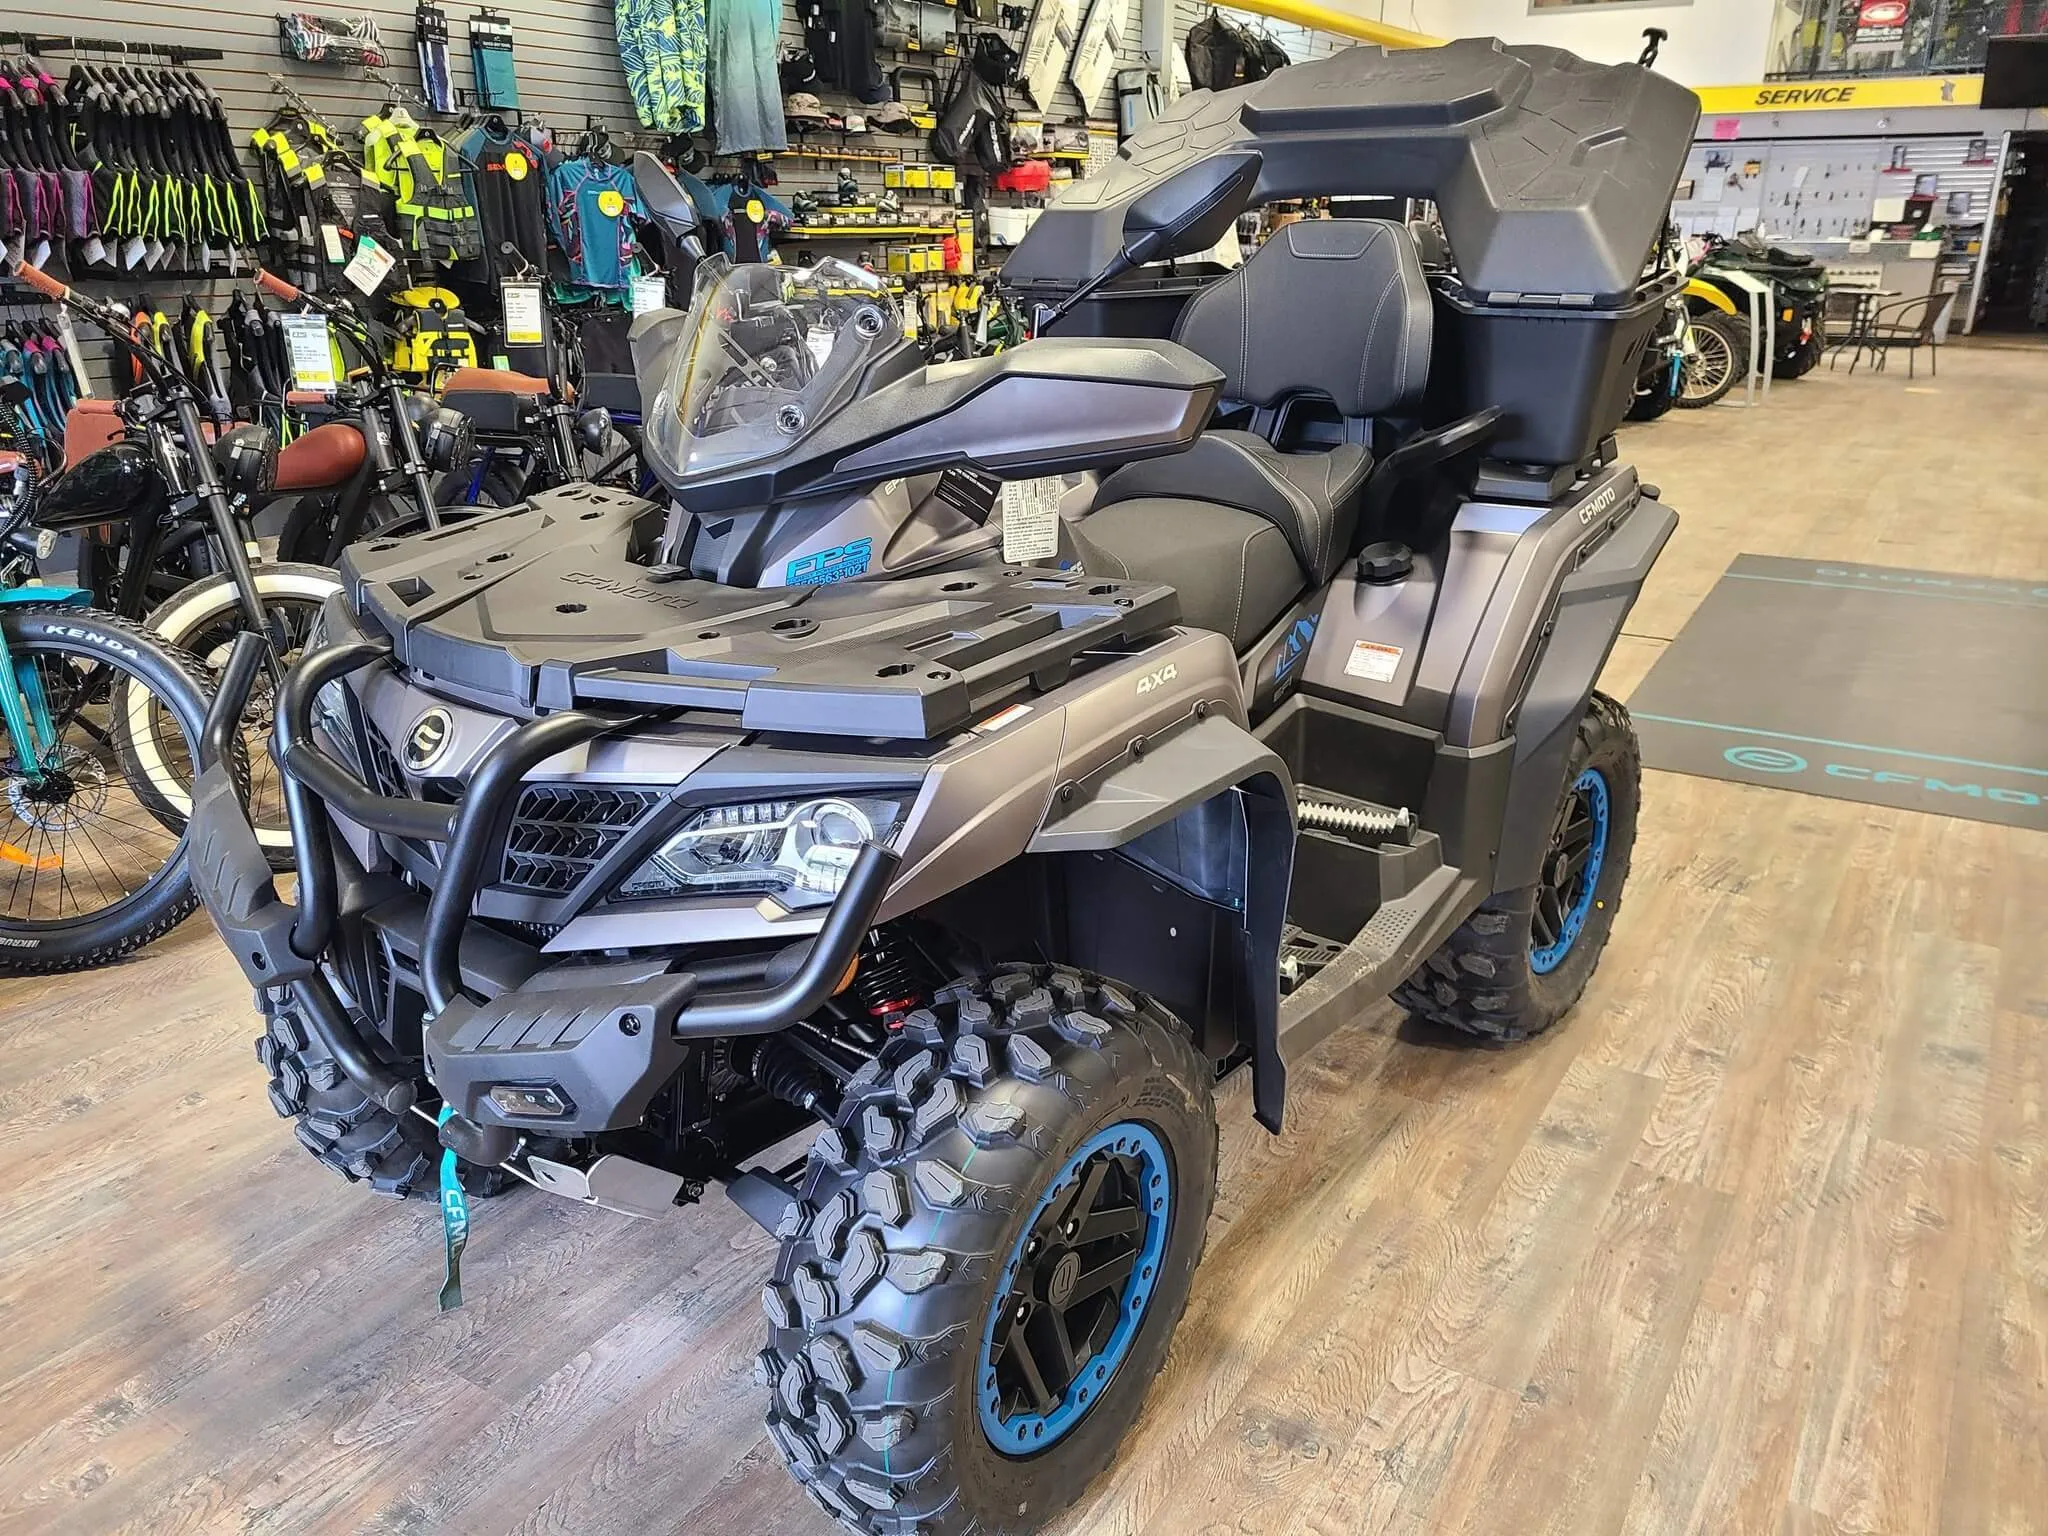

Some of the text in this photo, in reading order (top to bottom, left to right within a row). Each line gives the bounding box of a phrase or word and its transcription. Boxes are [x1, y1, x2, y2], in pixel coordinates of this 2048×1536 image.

[1755, 86, 1856, 106] SERVICE
[1579, 487, 1616, 525] CFMOTO
[559, 572, 699, 609] CFMOTO
[43, 625, 139, 660] KENDA
[1824, 763, 2048, 806] CFMO
